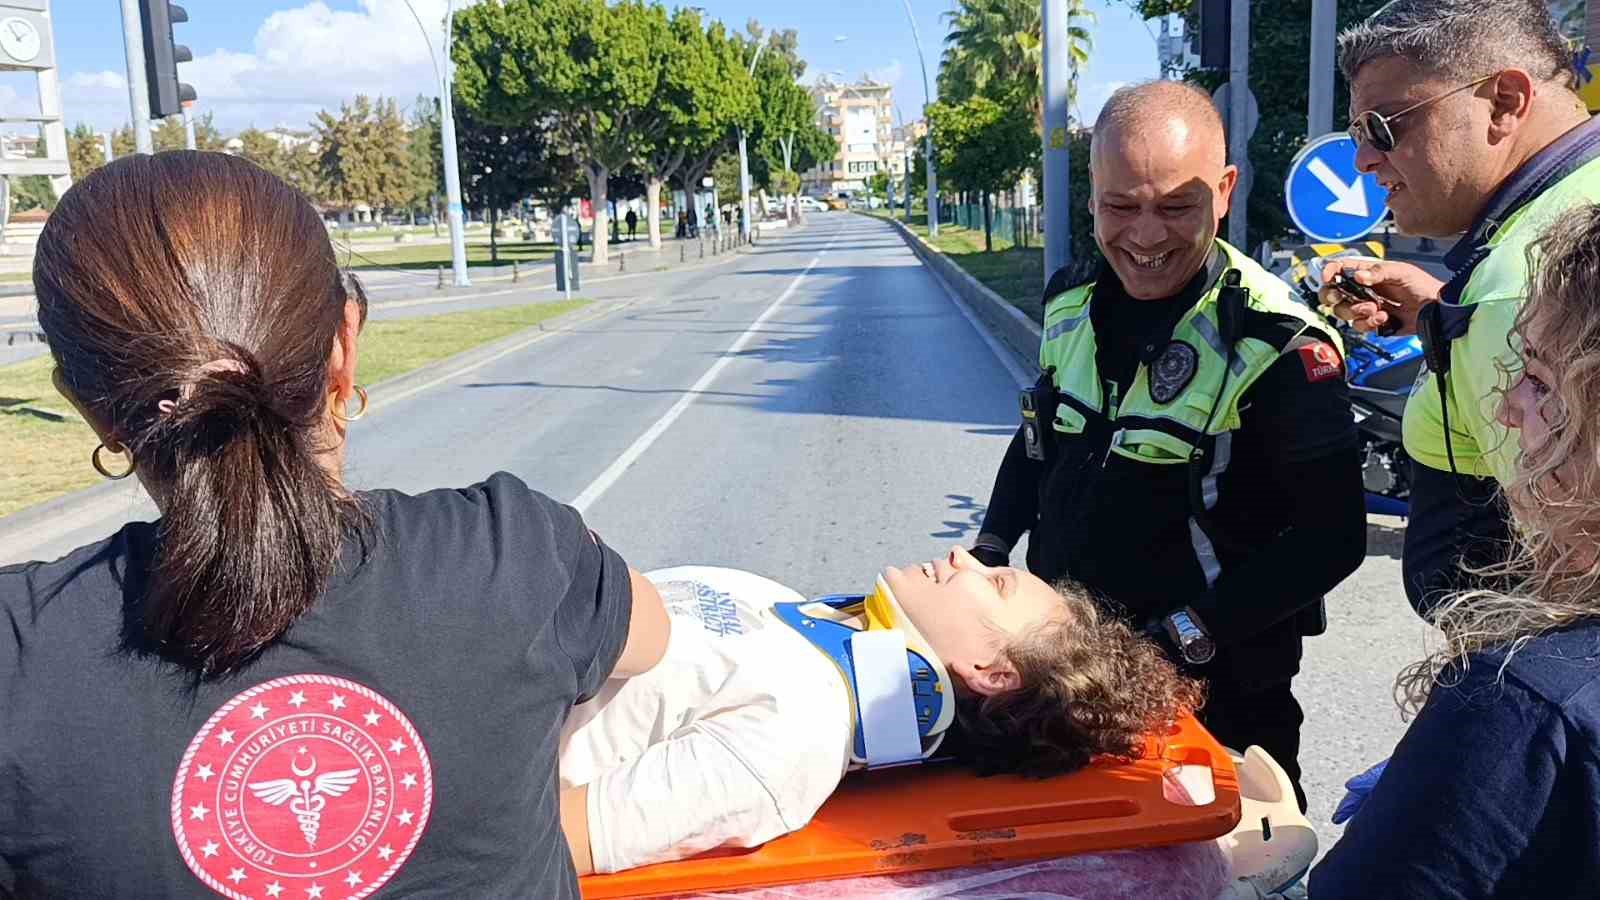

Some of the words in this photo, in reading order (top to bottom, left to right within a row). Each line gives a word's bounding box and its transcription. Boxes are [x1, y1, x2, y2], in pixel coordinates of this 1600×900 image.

[225, 719, 316, 802] CUMHURİYETİ
[321, 722, 375, 762] SAĞLIK
[225, 809, 276, 865] TÜRKİYE
[349, 764, 388, 852] BAKANLIĞI
